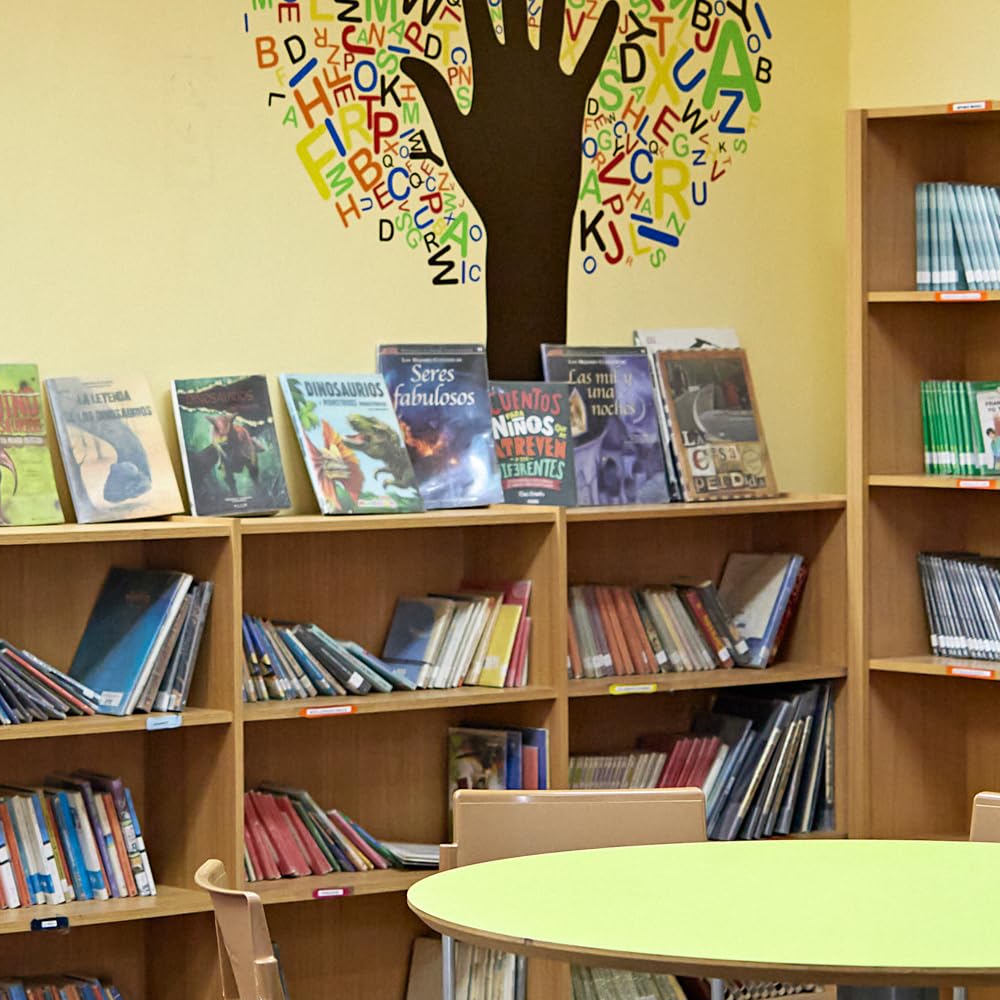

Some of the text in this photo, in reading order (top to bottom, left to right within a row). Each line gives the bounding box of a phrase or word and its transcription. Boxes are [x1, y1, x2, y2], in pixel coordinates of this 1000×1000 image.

[692, 0, 712, 32] B
[410, 364, 454, 383] Seres
[568, 369, 592, 385] Las
[304, 381, 384, 398] DINOSAURIOS
[393, 383, 476, 409] fabulosos
[587, 386, 616, 399] una
